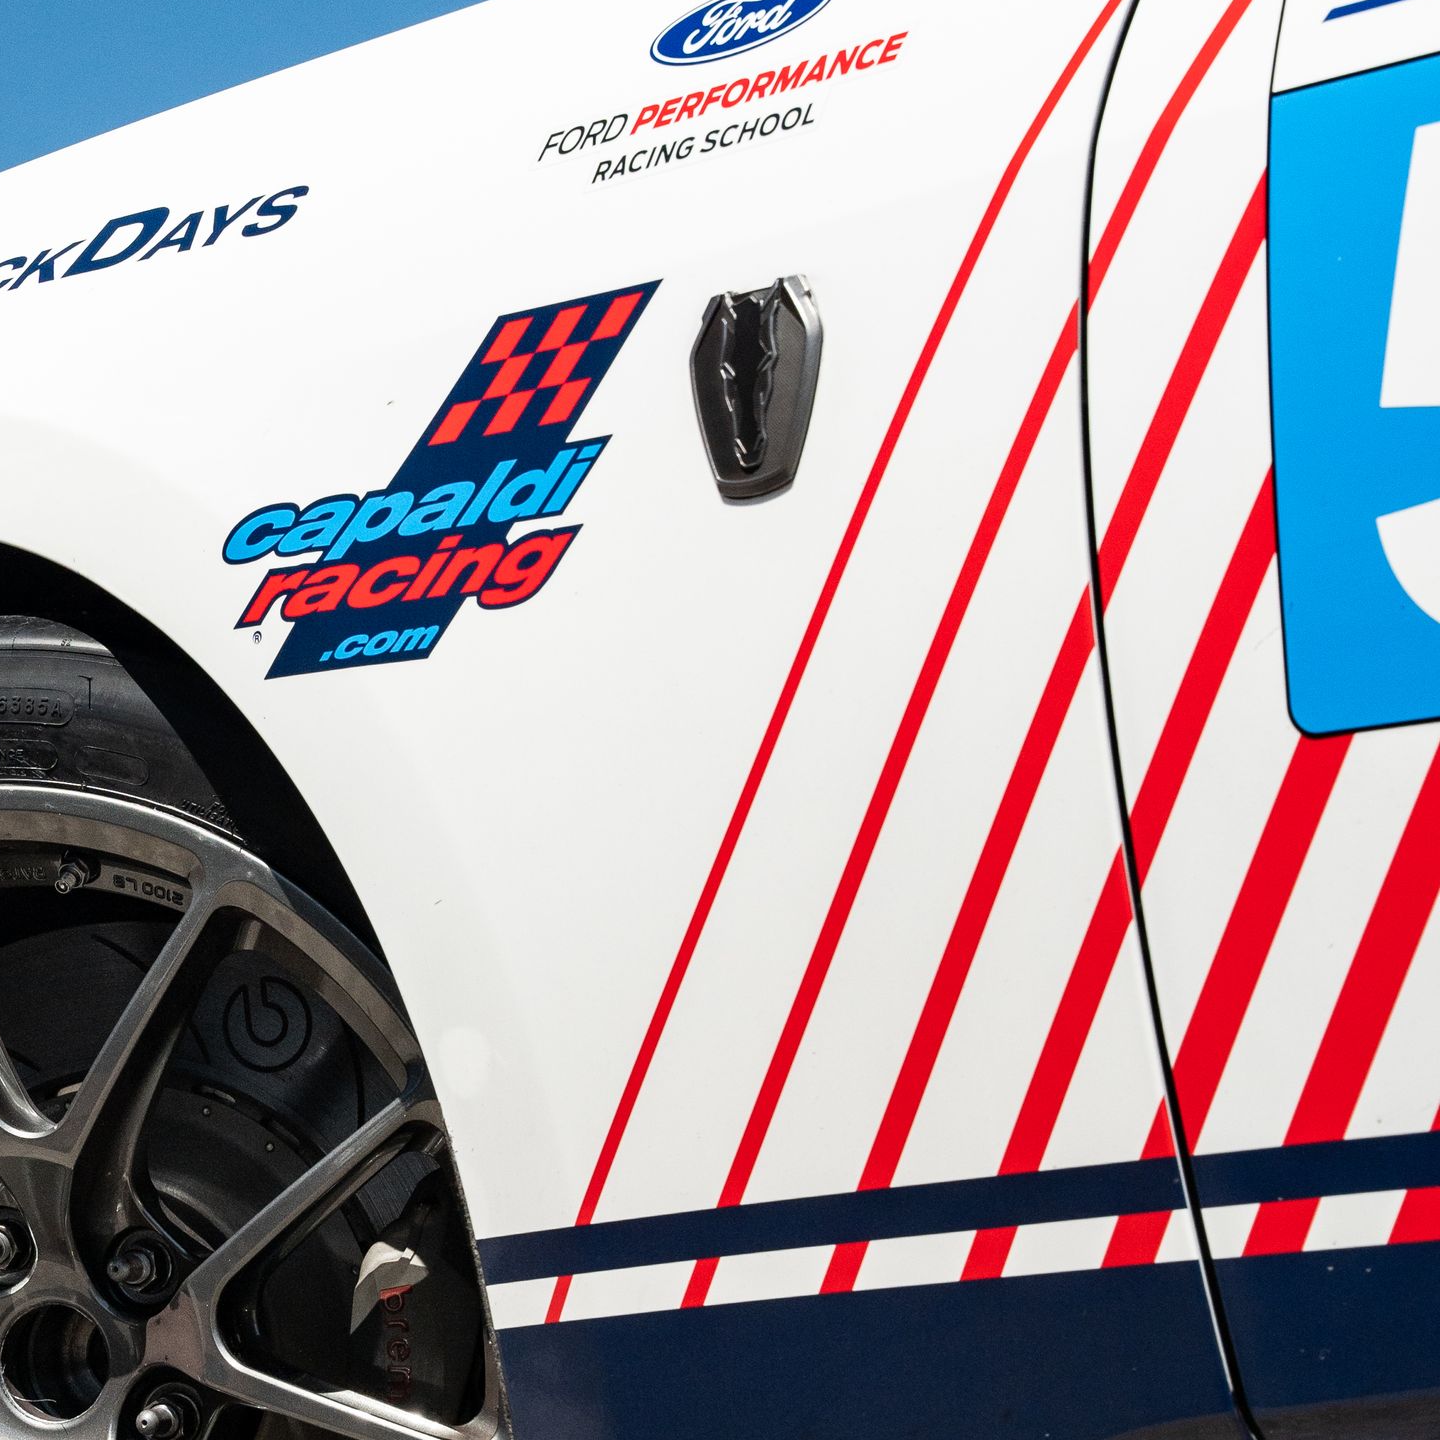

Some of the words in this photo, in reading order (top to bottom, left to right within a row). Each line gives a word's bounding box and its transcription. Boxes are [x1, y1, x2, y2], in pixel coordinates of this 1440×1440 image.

[538, 113, 629, 162] FORD
[629, 31, 908, 136] PERFORMANCE
[591, 136, 695, 184] RACING
[699, 103, 815, 153] SCHOOL
[224, 442, 601, 560] capaldi
[242, 526, 581, 624] racing
[319, 623, 440, 662] .com
[141, 881, 185, 906] 2100
